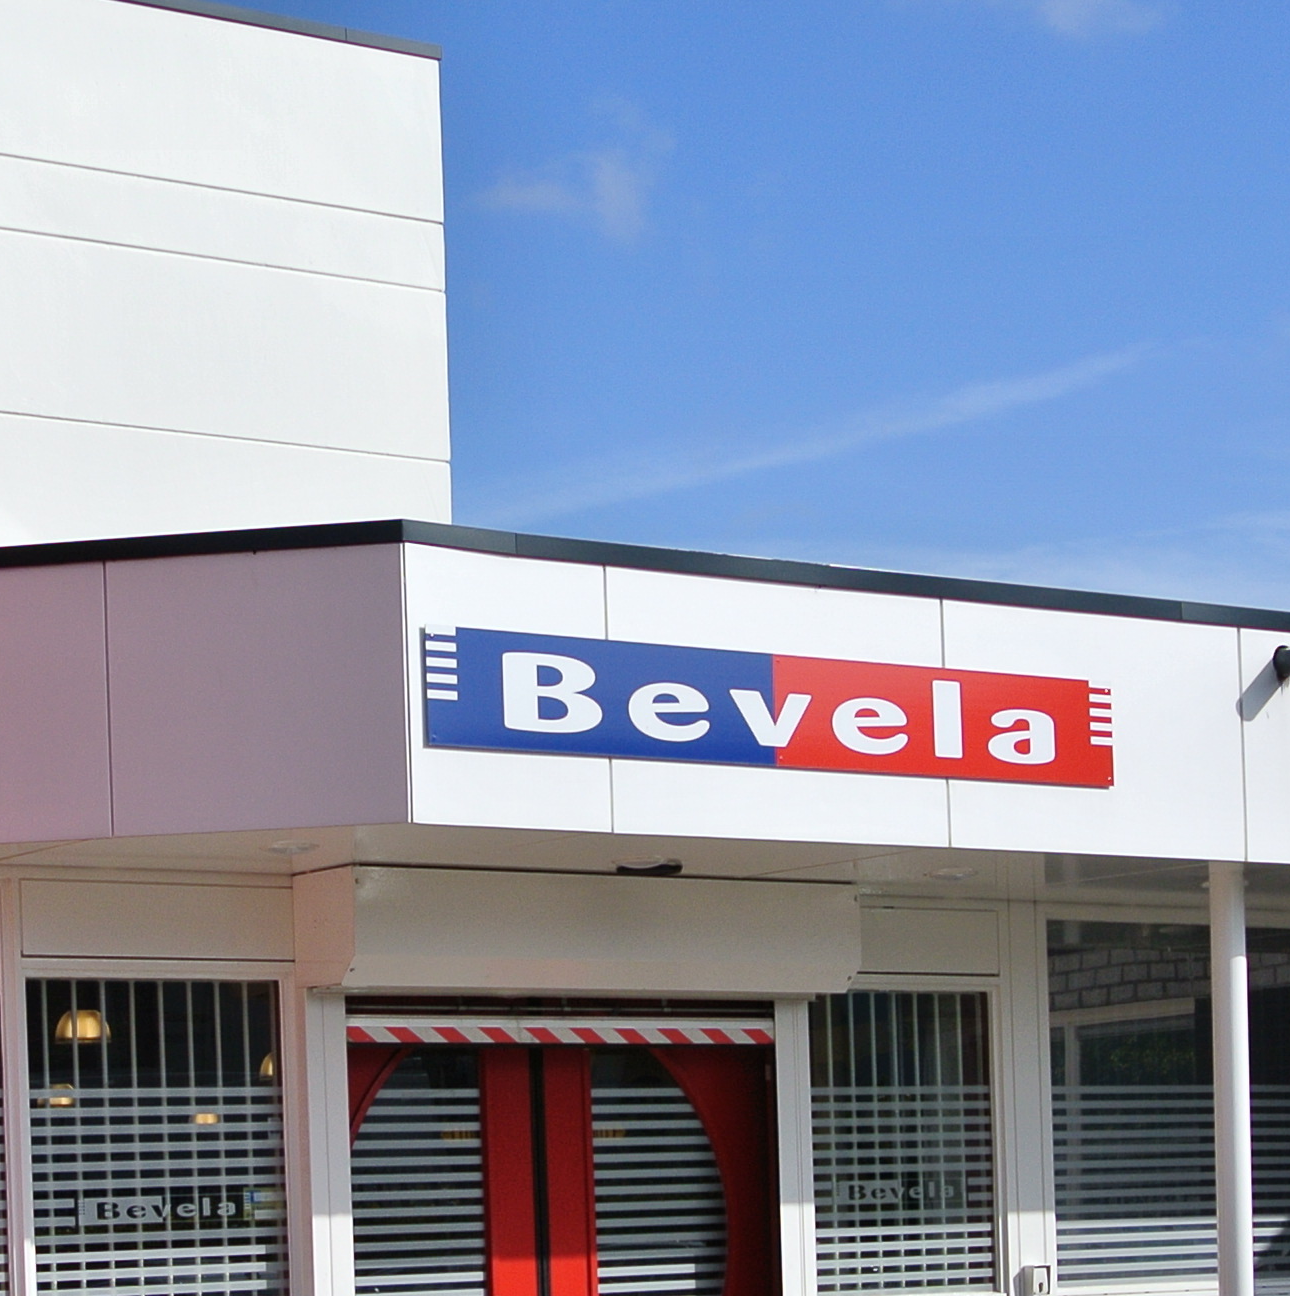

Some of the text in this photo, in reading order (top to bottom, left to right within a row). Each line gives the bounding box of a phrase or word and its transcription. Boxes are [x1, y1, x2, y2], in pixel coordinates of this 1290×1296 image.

[501, 650, 1057, 765] Bevela
[848, 1181, 955, 1201] Bevela
[96, 1197, 237, 1221] Bevela
